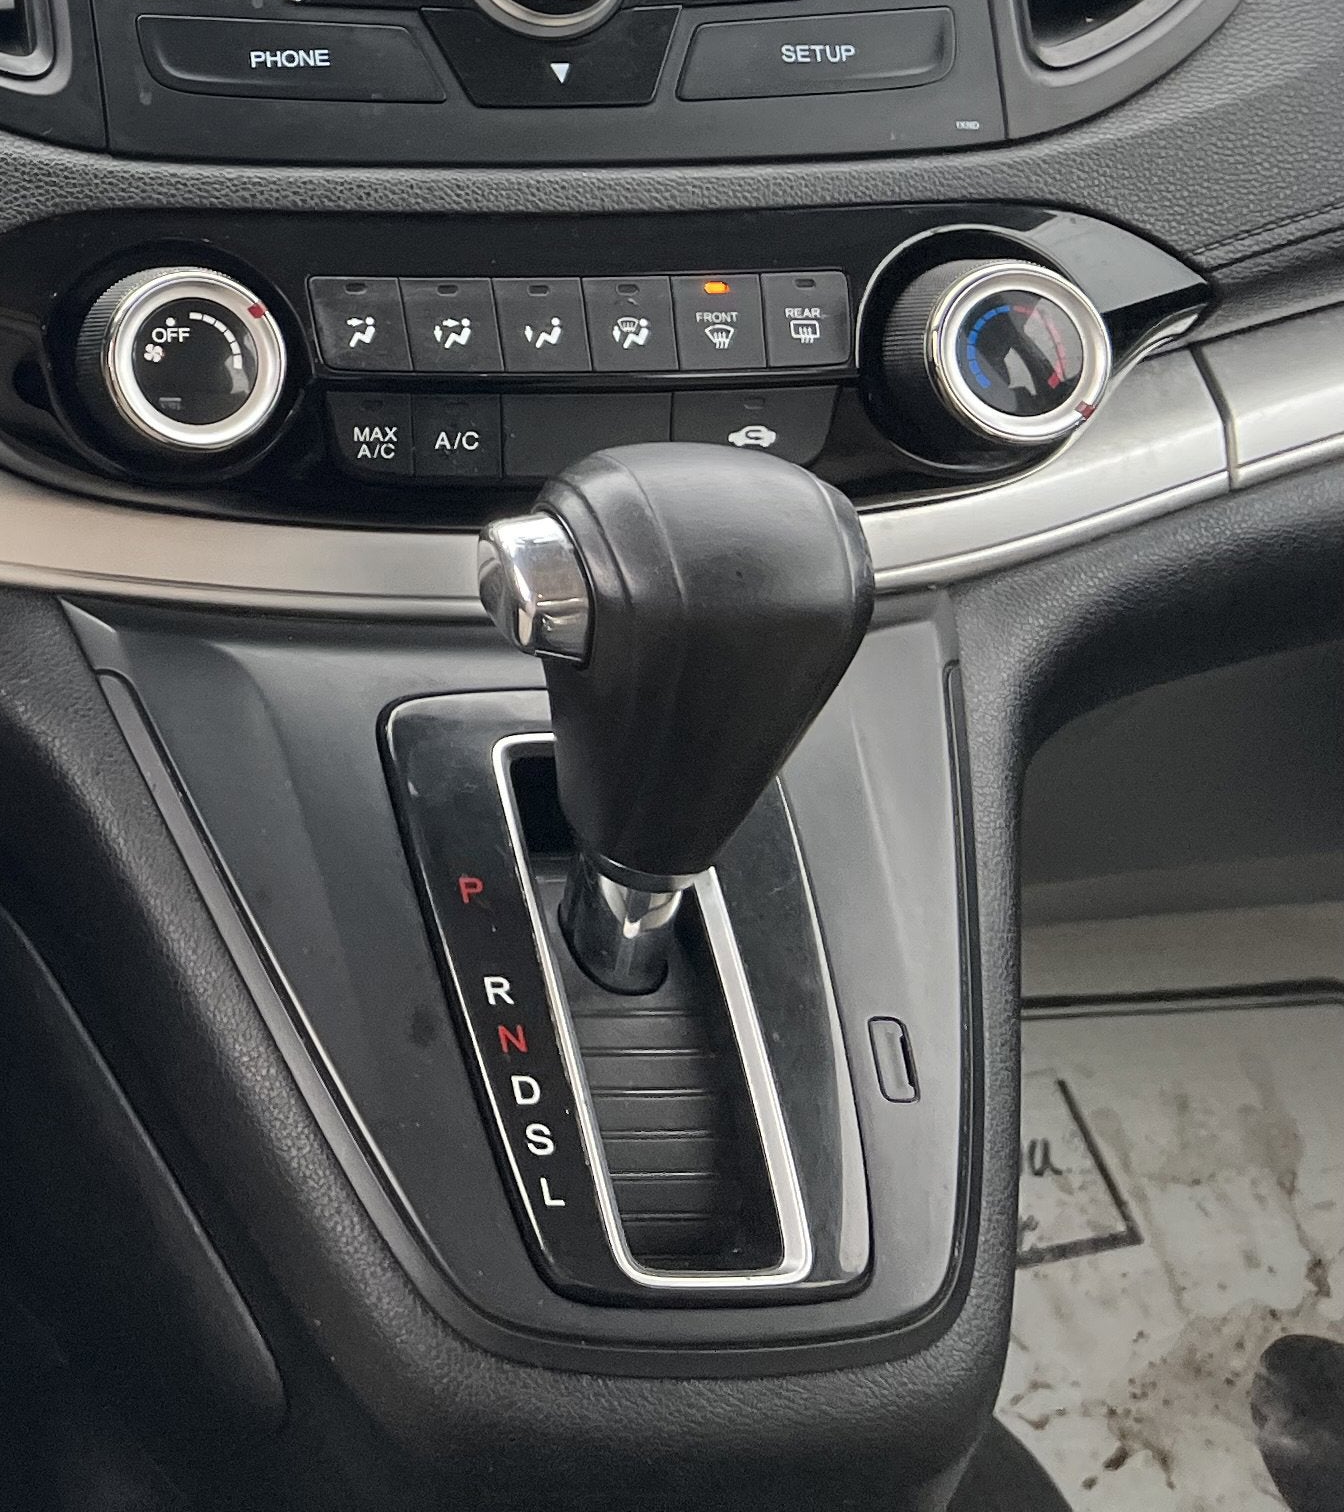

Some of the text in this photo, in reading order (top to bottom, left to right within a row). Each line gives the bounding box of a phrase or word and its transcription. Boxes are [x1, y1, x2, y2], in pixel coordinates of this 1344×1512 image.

[249, 49, 331, 69] PHONE
[781, 43, 856, 63] SETUP
[695, 311, 738, 323] FRONT
[785, 307, 821, 319] REAR
[152, 327, 190, 344] OFF
[353, 426, 398, 442] MAX
[434, 431, 480, 451] A/C
[357, 441, 396, 459] A/C
[458, 877, 484, 904] P
[484, 976, 514, 1005] R
[498, 1025, 528, 1053] N
[511, 1076, 541, 1105] D
[525, 1124, 554, 1155] S
[540, 1178, 566, 1207] L
